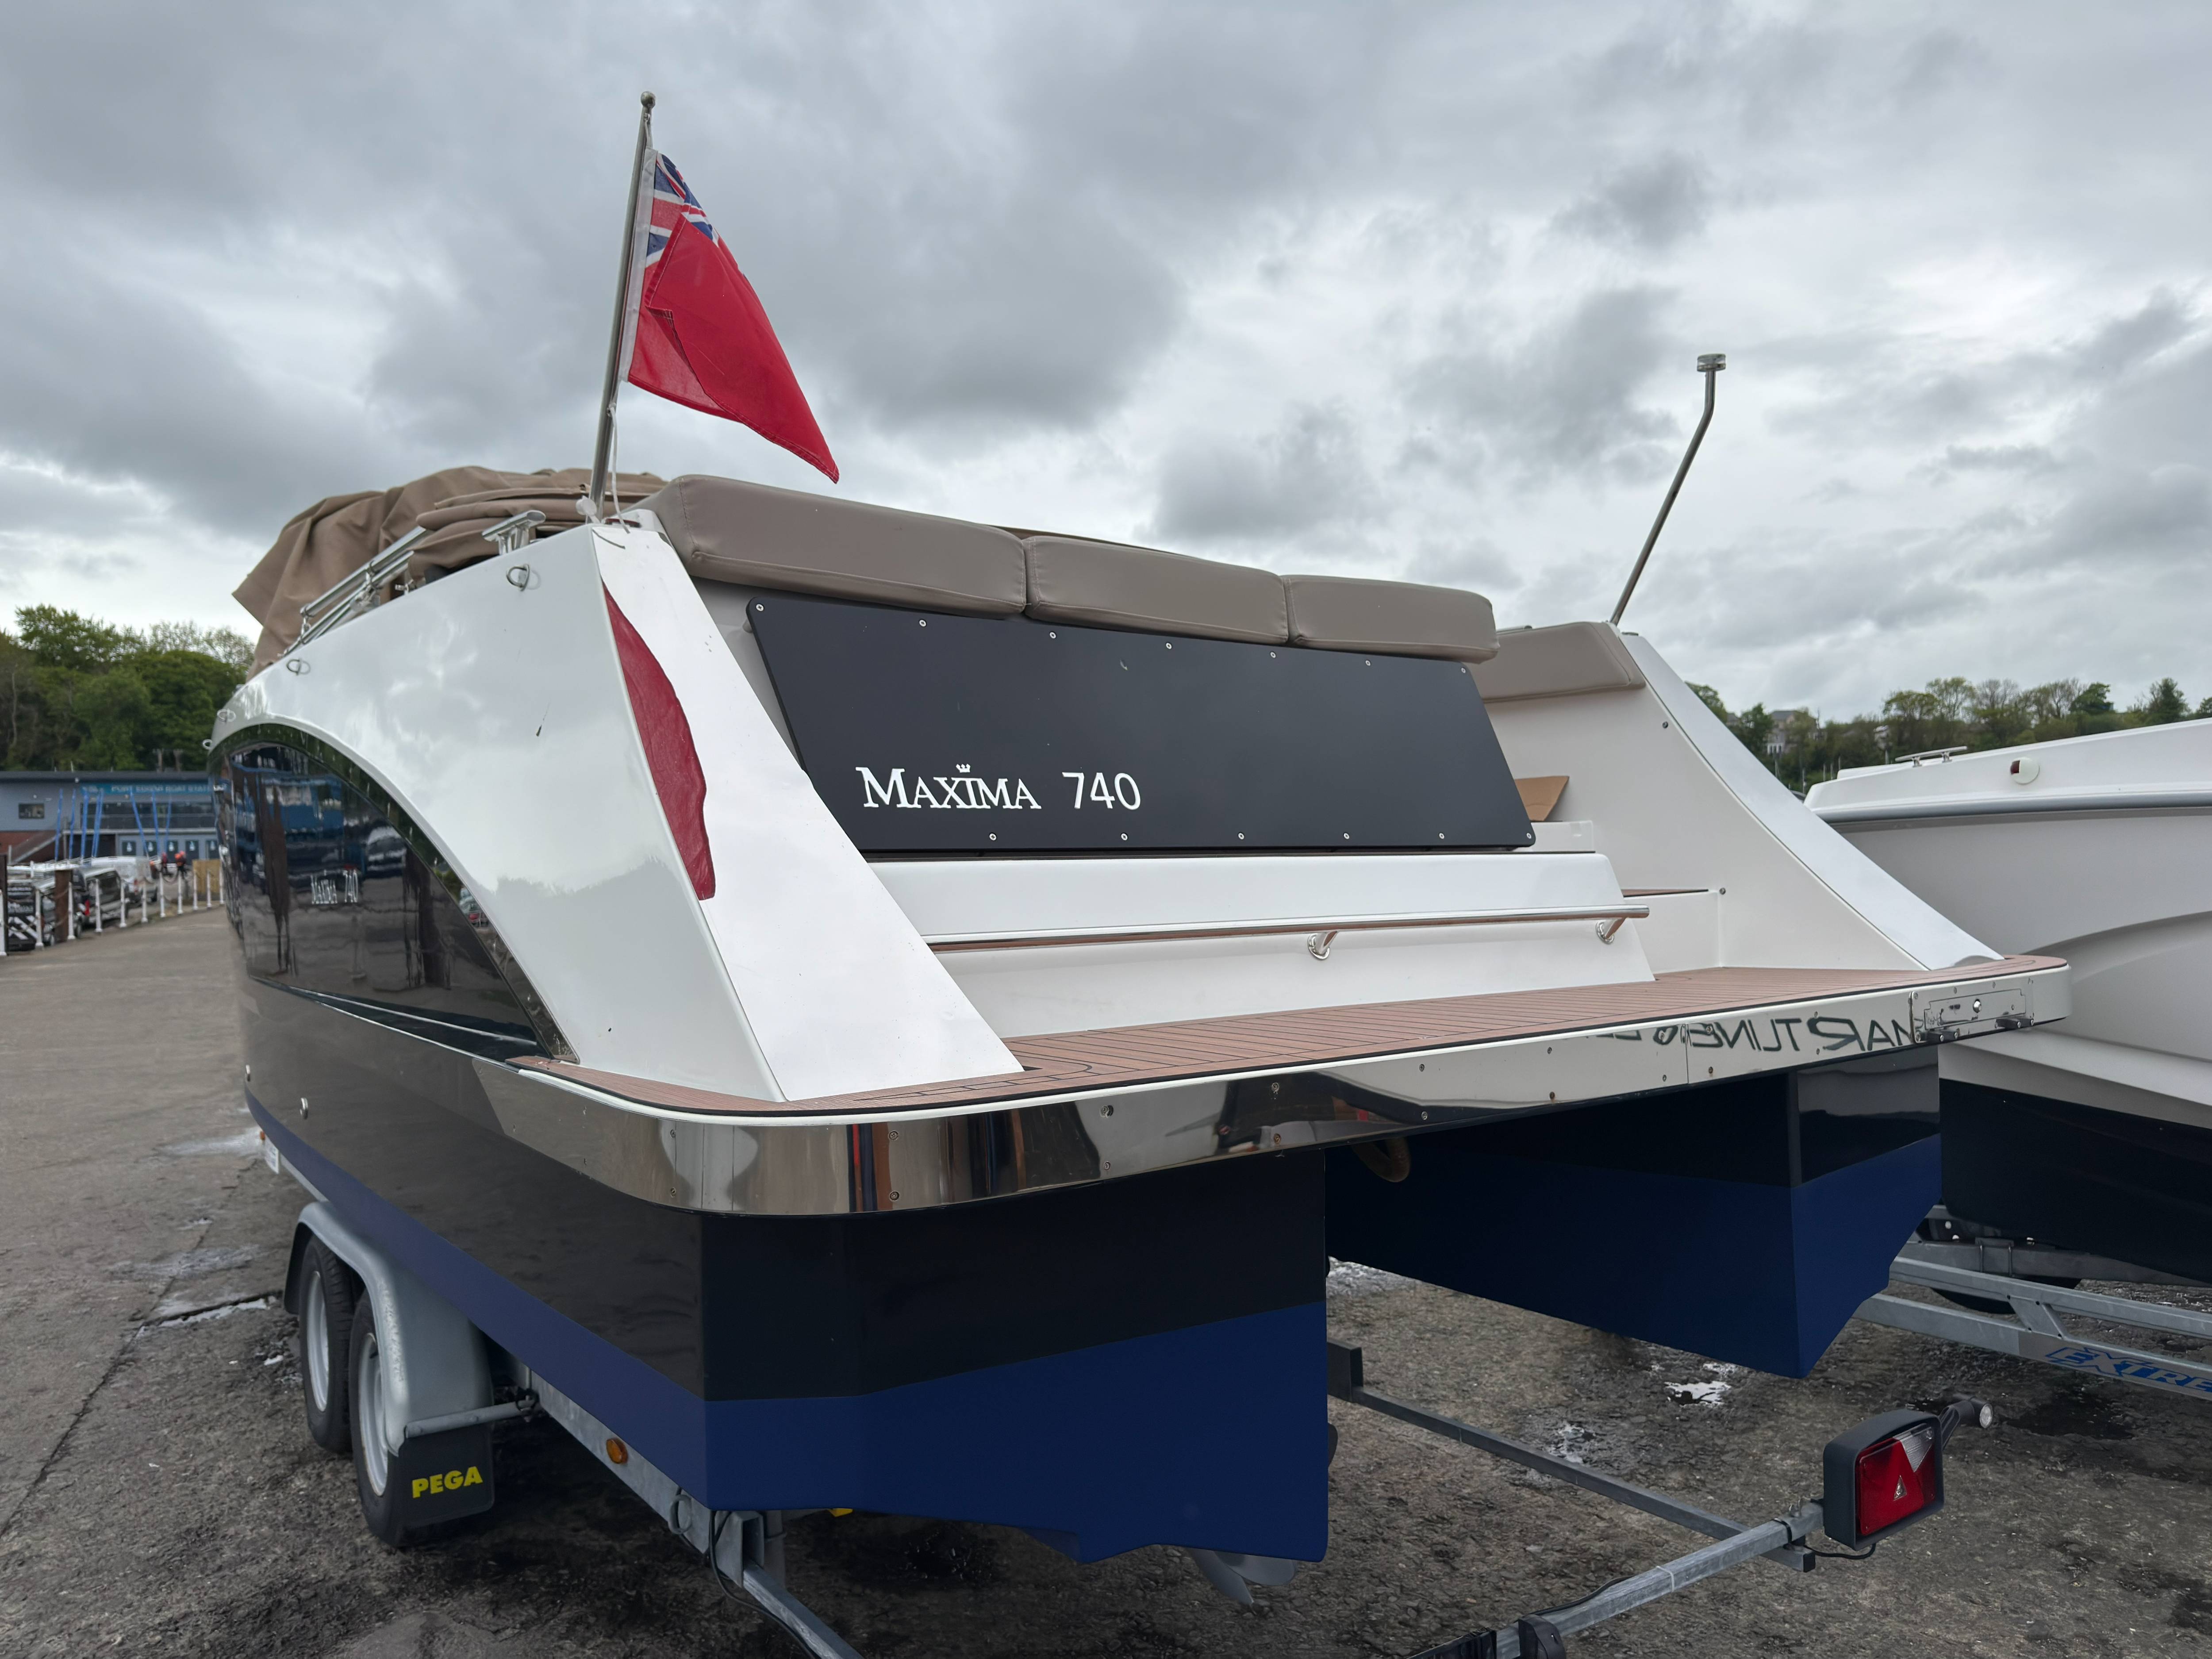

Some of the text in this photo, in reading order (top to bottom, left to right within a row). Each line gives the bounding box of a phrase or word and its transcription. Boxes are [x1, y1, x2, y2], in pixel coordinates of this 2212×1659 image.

[855, 767, 1141, 810] MAXIMA 740
[343, 869, 358, 903] 740
[412, 1466, 483, 1499] PEGA
